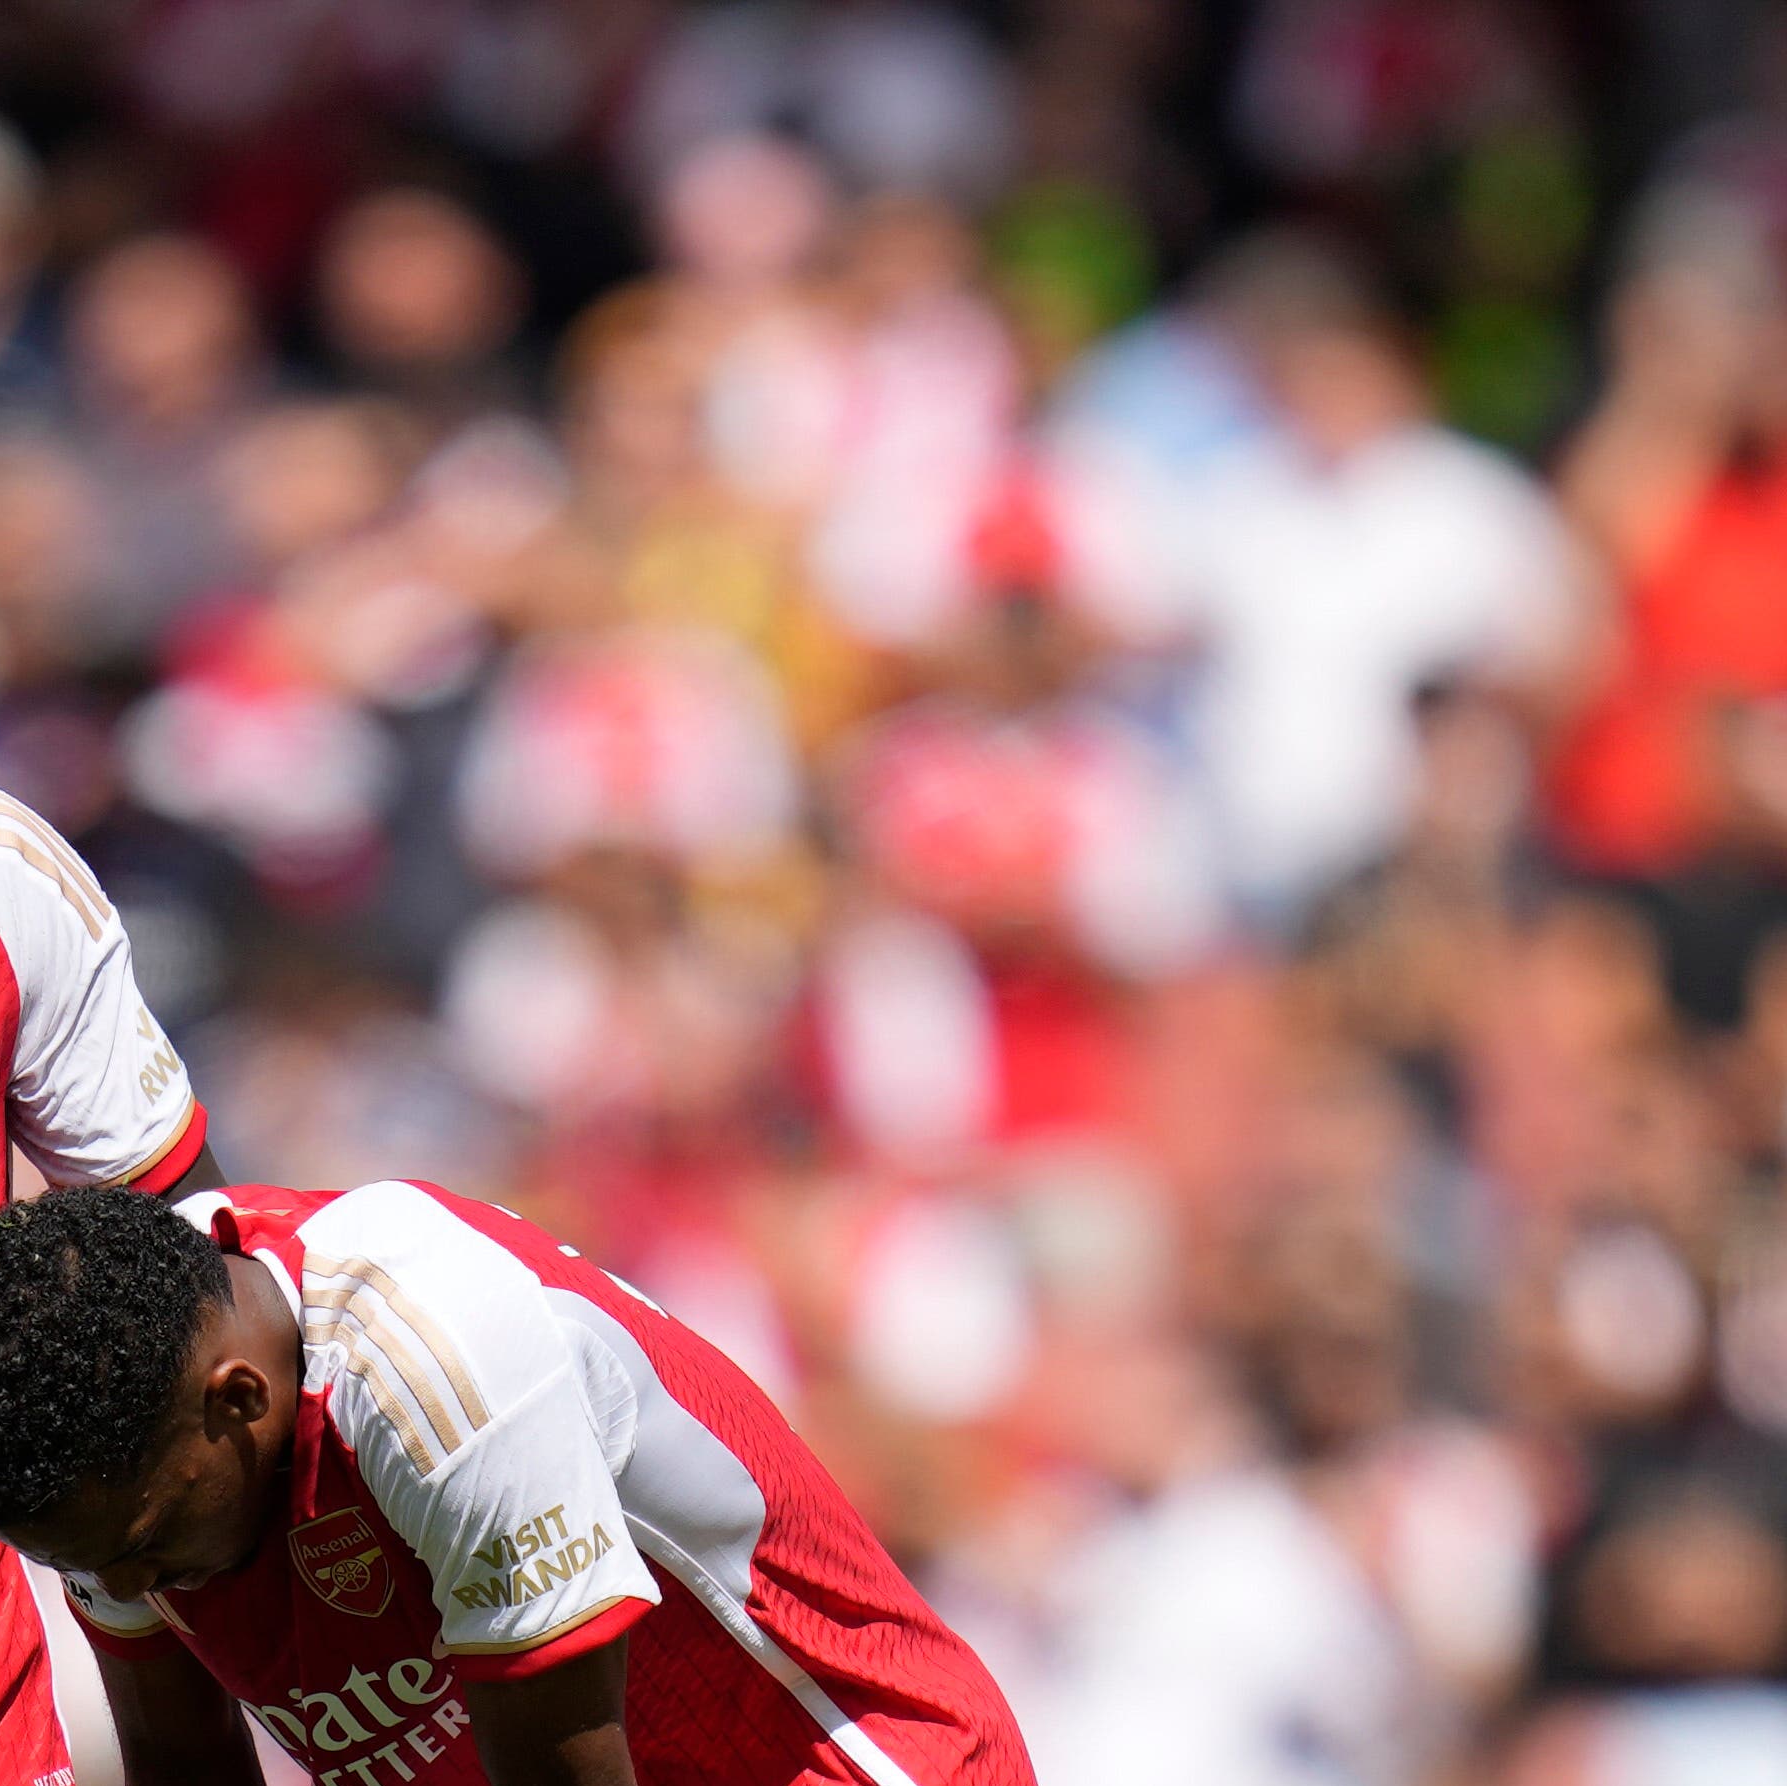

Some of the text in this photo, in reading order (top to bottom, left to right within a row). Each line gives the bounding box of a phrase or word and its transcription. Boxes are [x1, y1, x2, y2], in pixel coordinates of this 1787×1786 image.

[301, 1523, 370, 1559] Arsenal
[451, 1522, 616, 1611] RWANDA
[471, 1503, 569, 1570] VISIT
